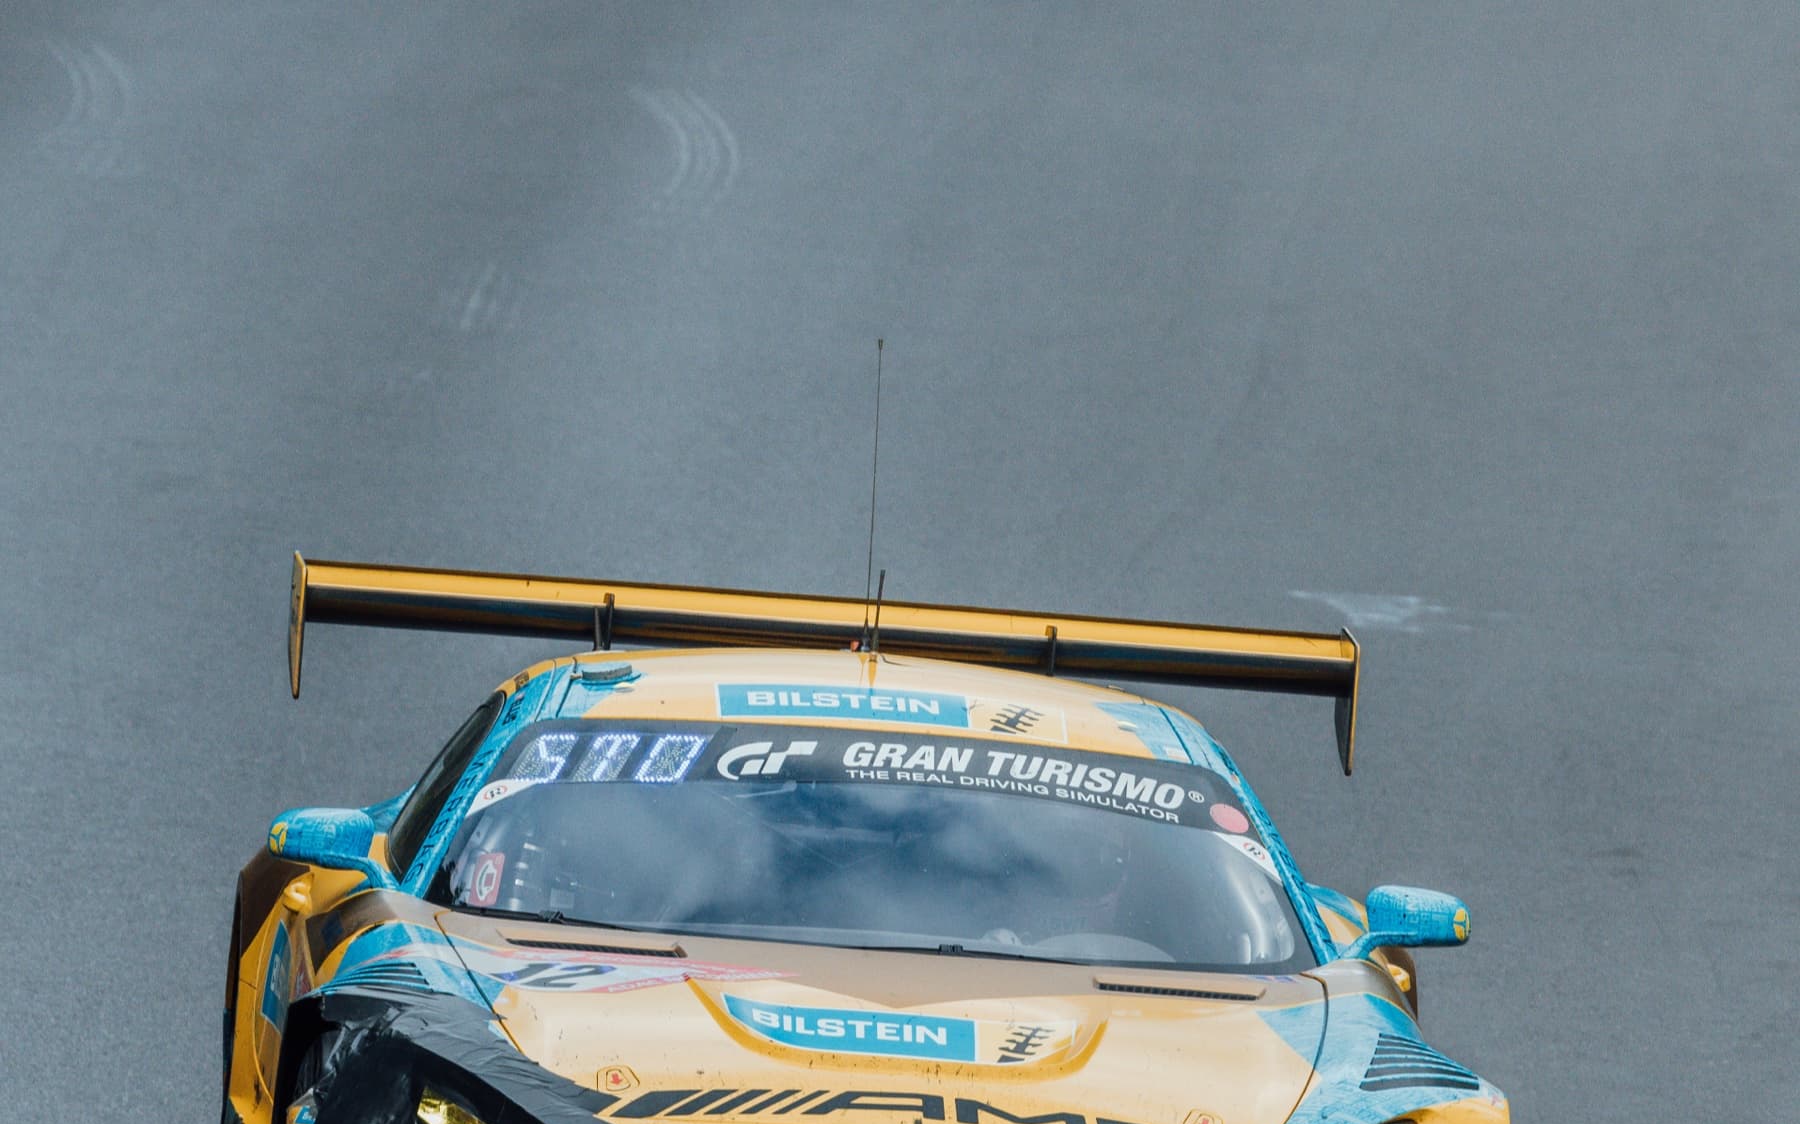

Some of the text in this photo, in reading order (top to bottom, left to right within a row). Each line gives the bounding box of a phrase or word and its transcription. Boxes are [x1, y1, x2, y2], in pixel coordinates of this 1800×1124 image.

[746, 690, 940, 715] BILSTEIN
[842, 741, 974, 773] GRAN
[846, 770, 1180, 824] THE REAL DRIVING SIMULATOR
[490, 962, 617, 988] 12
[751, 1007, 947, 1045] BILSTEIN
